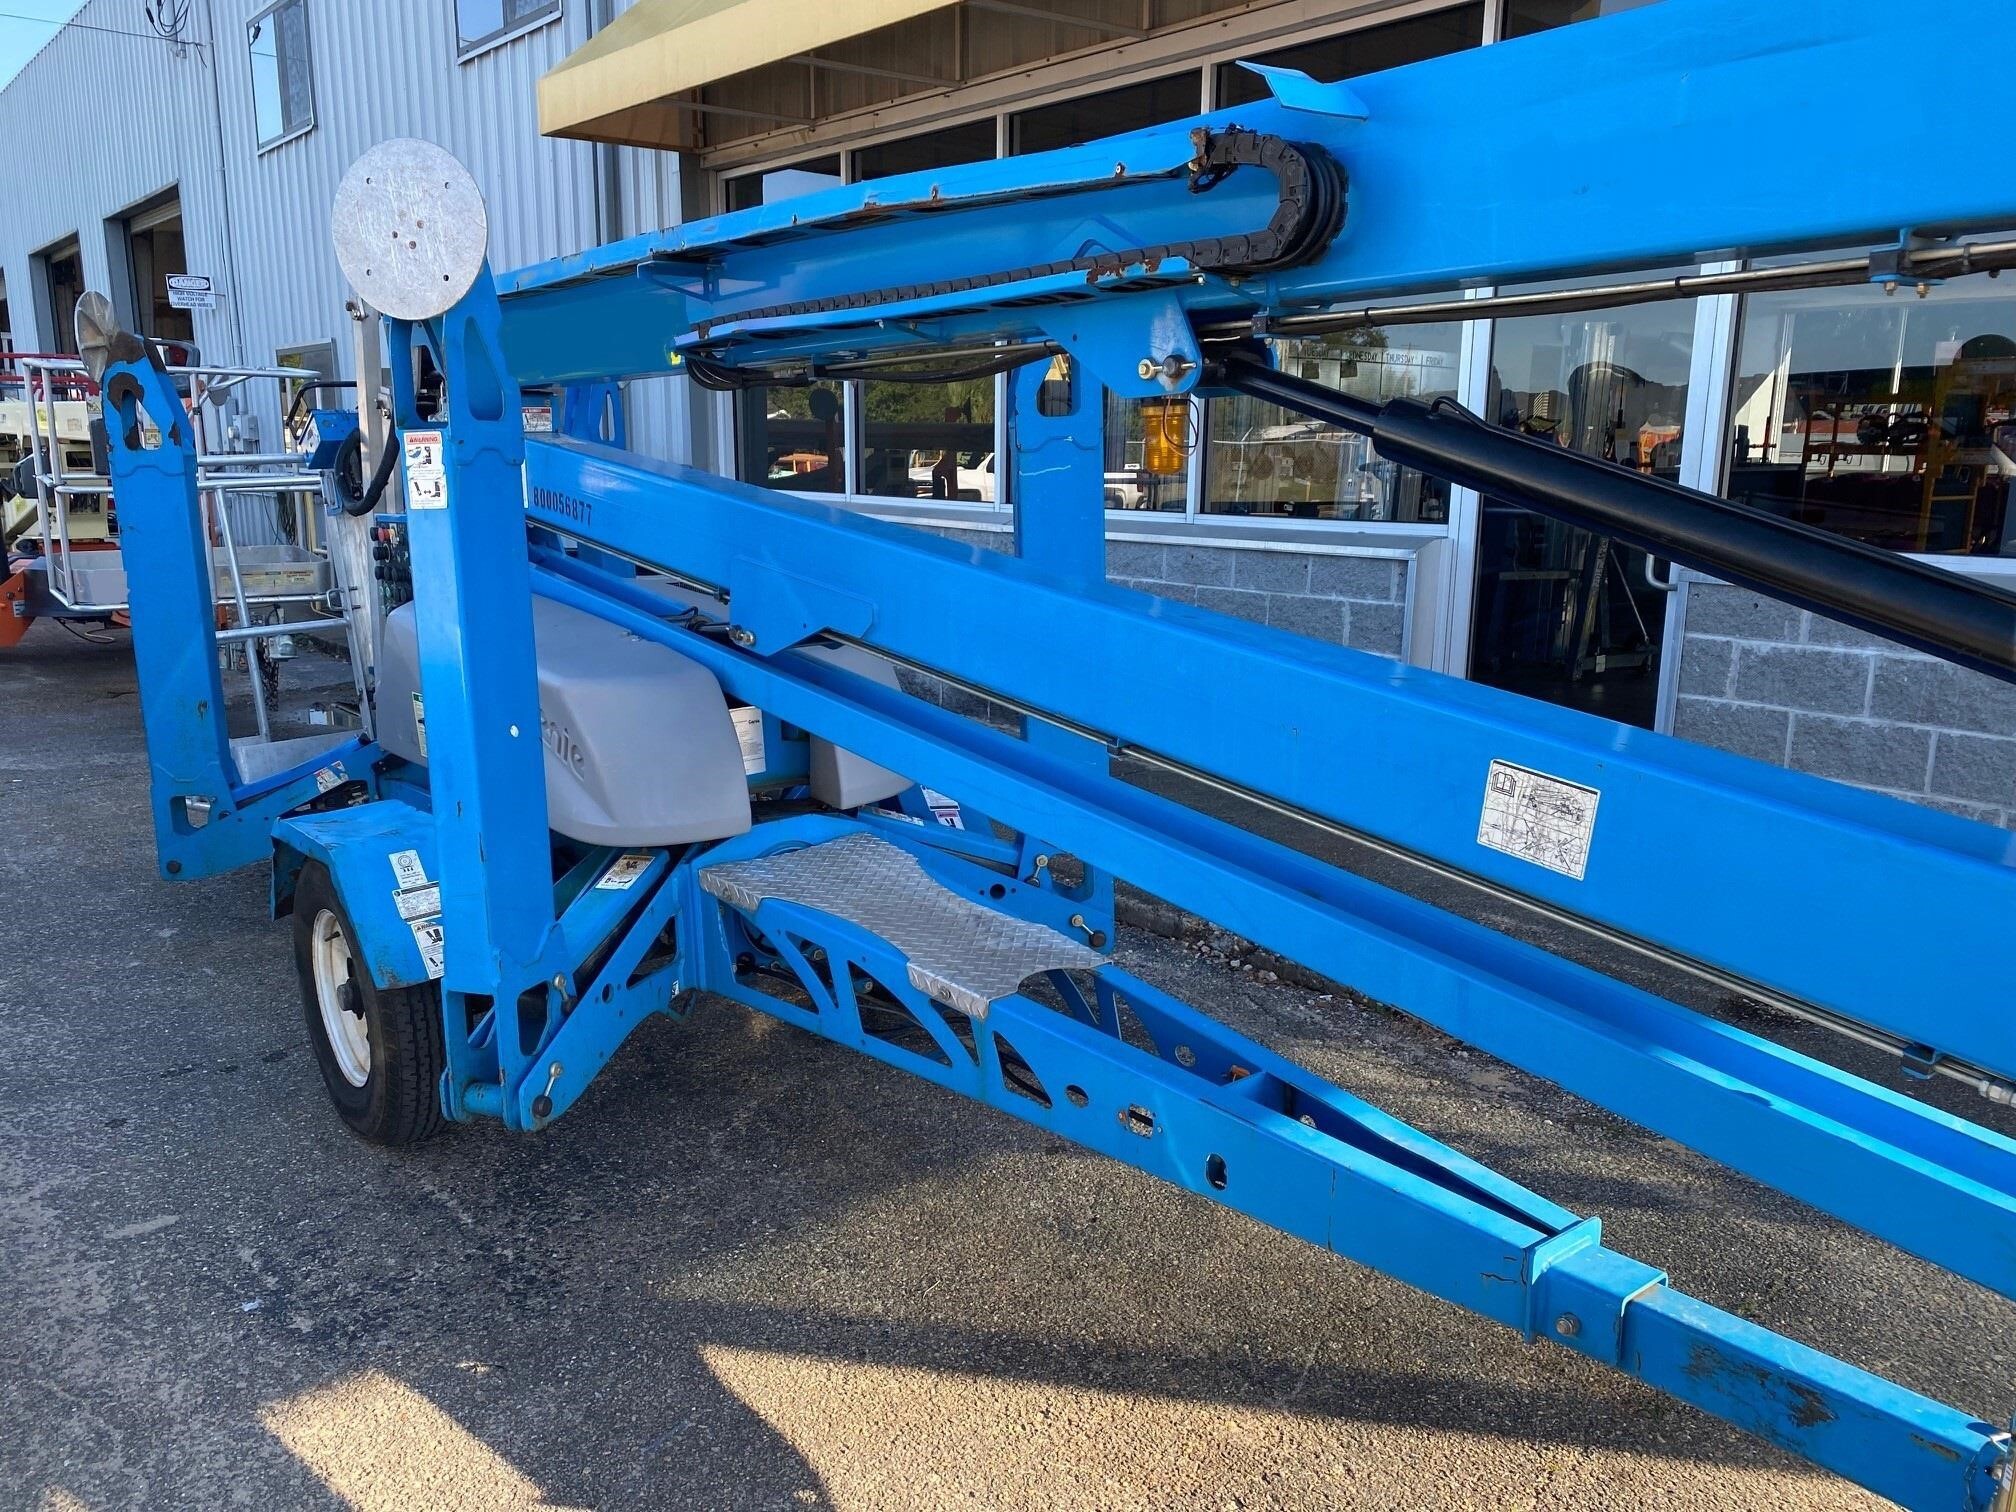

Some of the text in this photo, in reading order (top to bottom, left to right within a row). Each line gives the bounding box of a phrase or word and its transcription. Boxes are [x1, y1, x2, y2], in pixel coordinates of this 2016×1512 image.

[1386, 352, 1415, 365] THURSDAY
[1425, 355, 1444, 366] FRIDAY
[533, 485, 592, 527] 800056877
